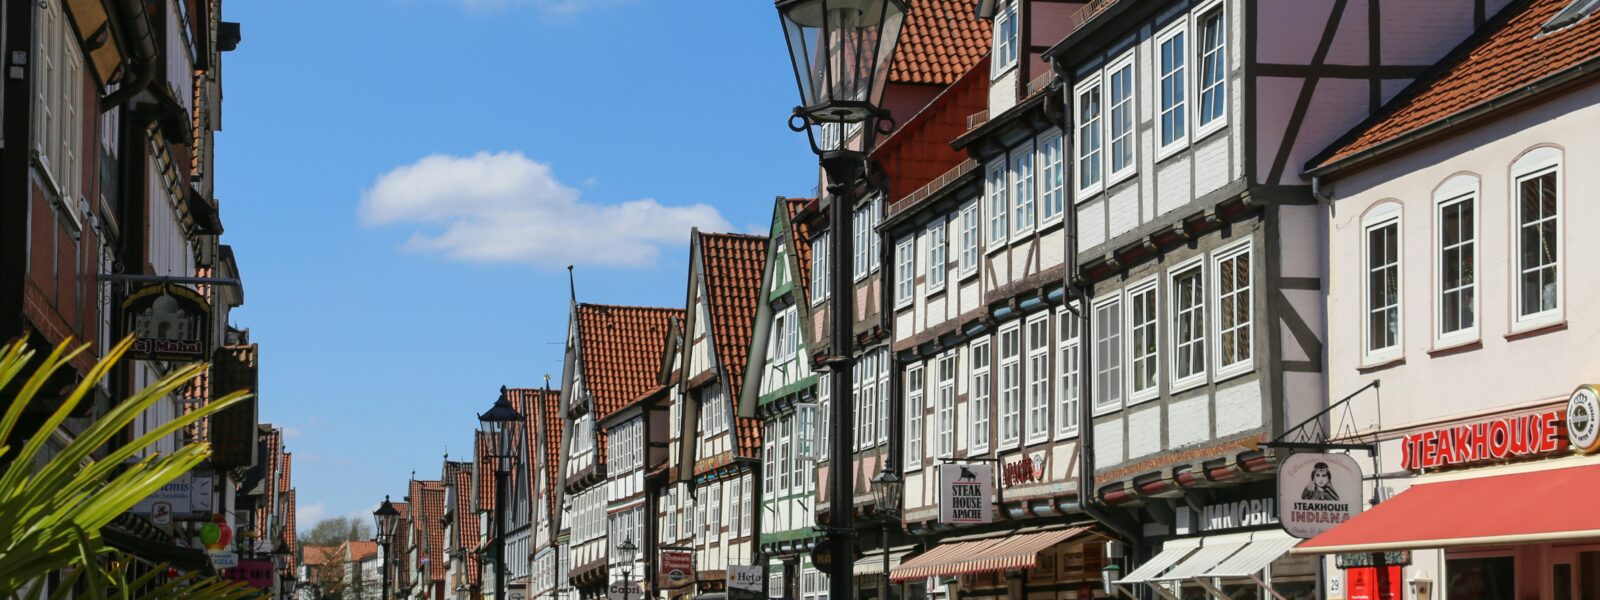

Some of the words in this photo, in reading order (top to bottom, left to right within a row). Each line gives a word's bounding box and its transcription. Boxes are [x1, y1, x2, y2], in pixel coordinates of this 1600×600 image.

[154, 340, 202, 354] Mahal
[1401, 411, 1559, 470] STEAKHOUSE
[952, 484, 982, 497] STEAK
[952, 496, 982, 509] HOUSE
[1293, 502, 1349, 512] STEAKHOUSE
[952, 508, 982, 519] APACHE
[1203, 497, 1279, 531] IMMOBIL
[1290, 510, 1352, 524] INDIANA
[1330, 579, 1339, 591] 29
